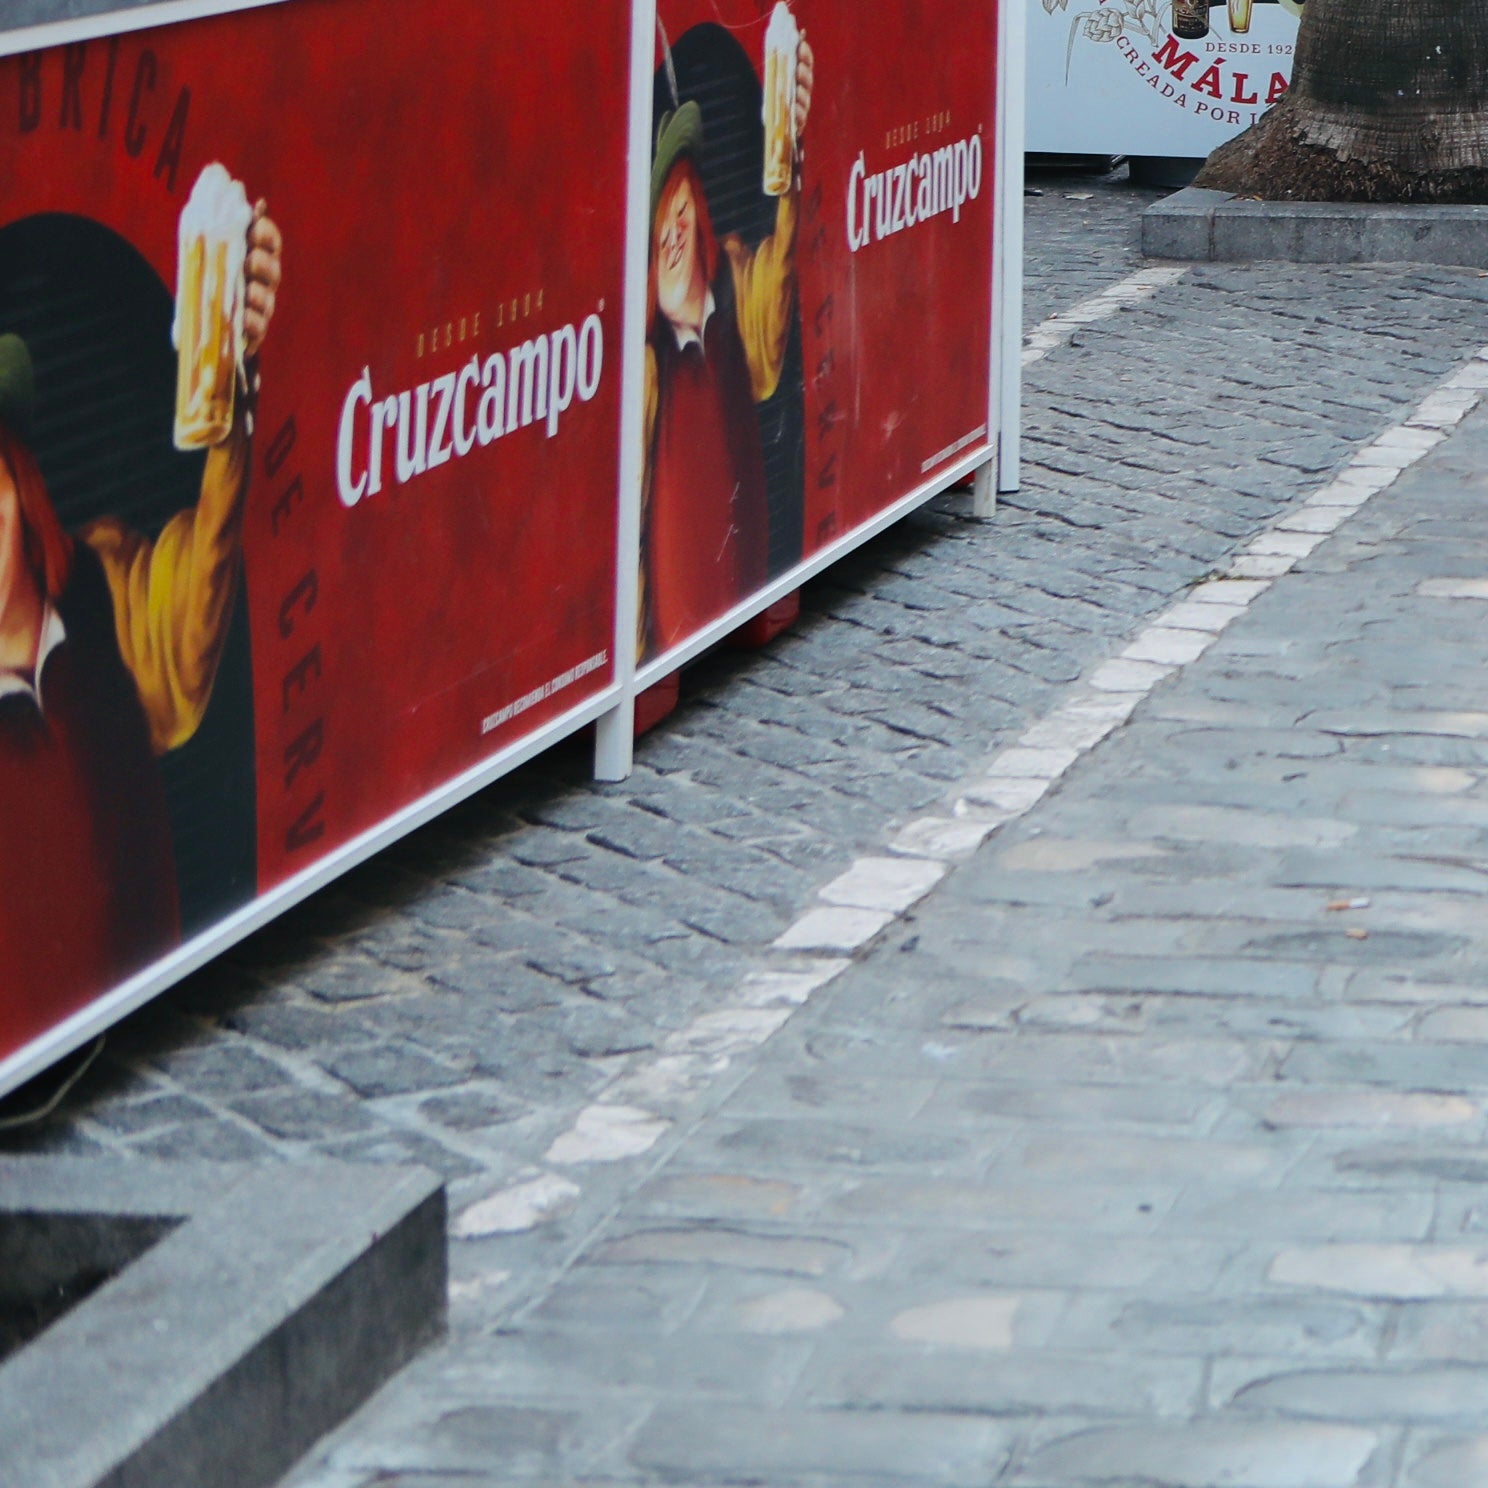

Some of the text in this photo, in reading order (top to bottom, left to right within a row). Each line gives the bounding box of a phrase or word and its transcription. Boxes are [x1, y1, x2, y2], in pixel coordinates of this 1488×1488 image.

[1116, 36, 1240, 124] CREADA POR
[1206, 42, 1261, 53] DESDE
[847, 149, 983, 253] Cruzcampo
[416, 312, 480, 358] DESDE
[336, 314, 603, 507] Cruzcampo
